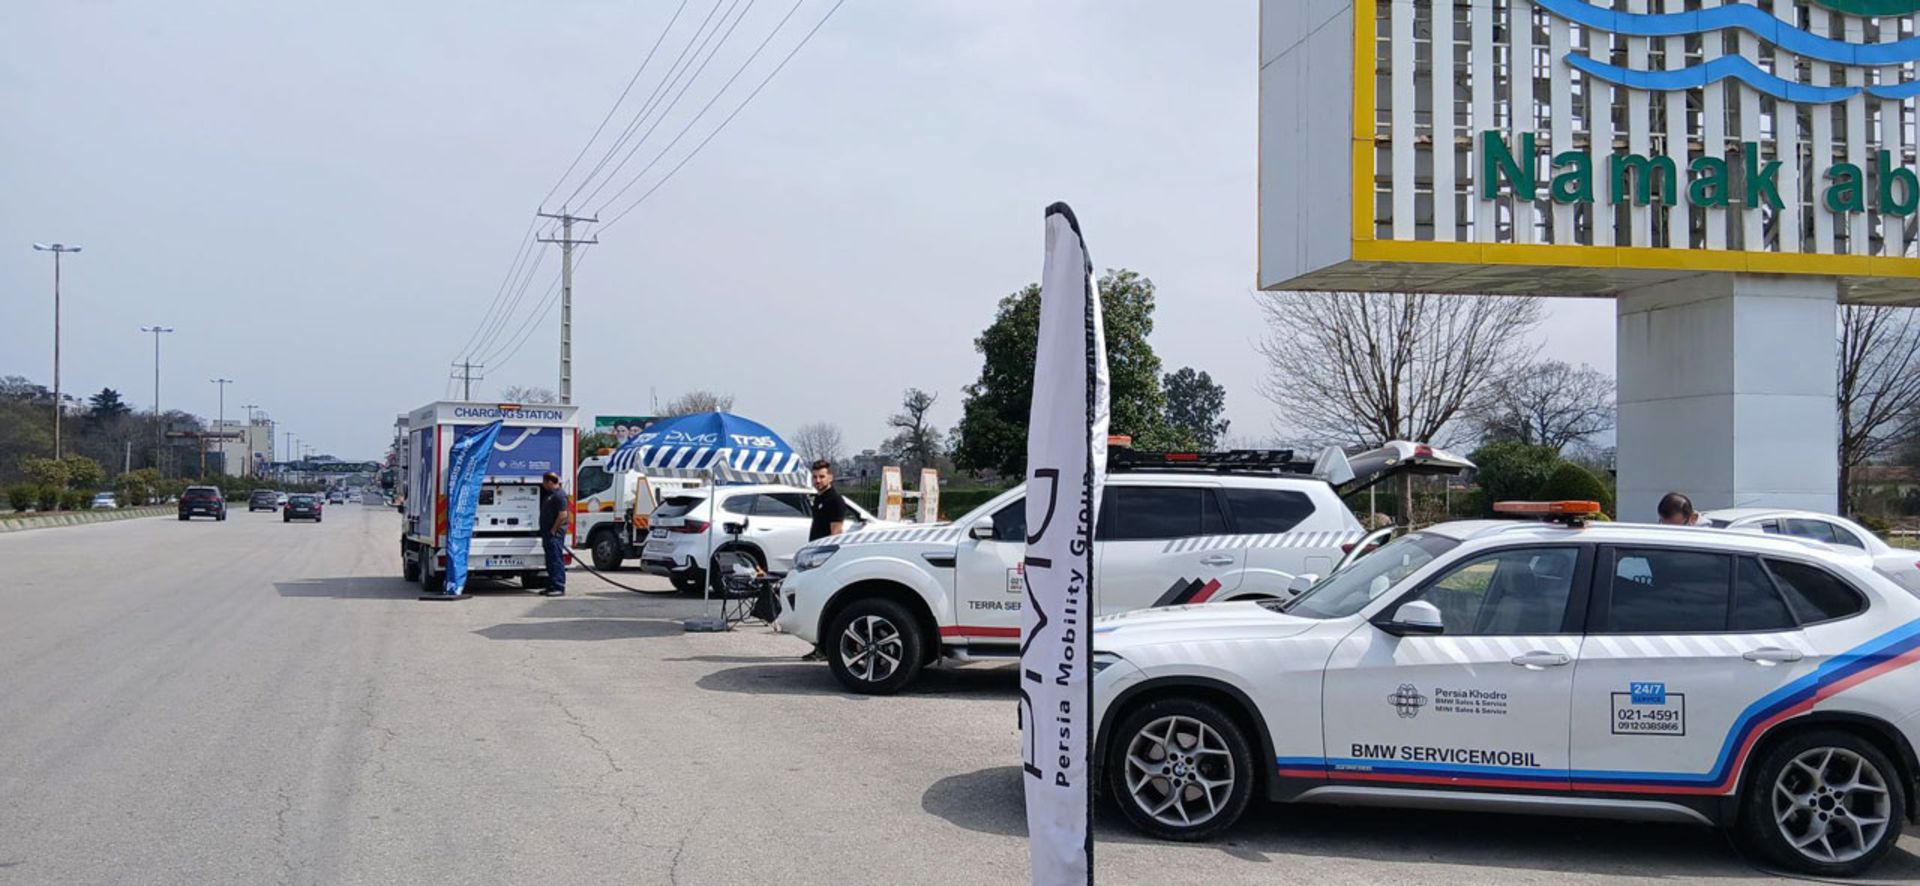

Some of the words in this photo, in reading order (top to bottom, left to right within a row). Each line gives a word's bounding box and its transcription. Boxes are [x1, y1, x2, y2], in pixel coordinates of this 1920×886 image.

[1480, 130, 1785, 210] Namak
[1823, 149, 1919, 217] ab
[455, 407, 515, 419] CHARGING
[516, 410, 563, 420] STATION
[967, 600, 1003, 610] TERRA
[1056, 568, 1084, 687] Mobility
[1435, 687, 1468, 698] Persia
[1469, 689, 1507, 700] Khodro
[1634, 684, 1661, 695] 24/7
[1617, 709, 1679, 721] 021-4591
[1055, 700, 1071, 788] Persia
[1351, 743, 1397, 759] BMW
[1400, 746, 1541, 768] SERVICEMOBIL
